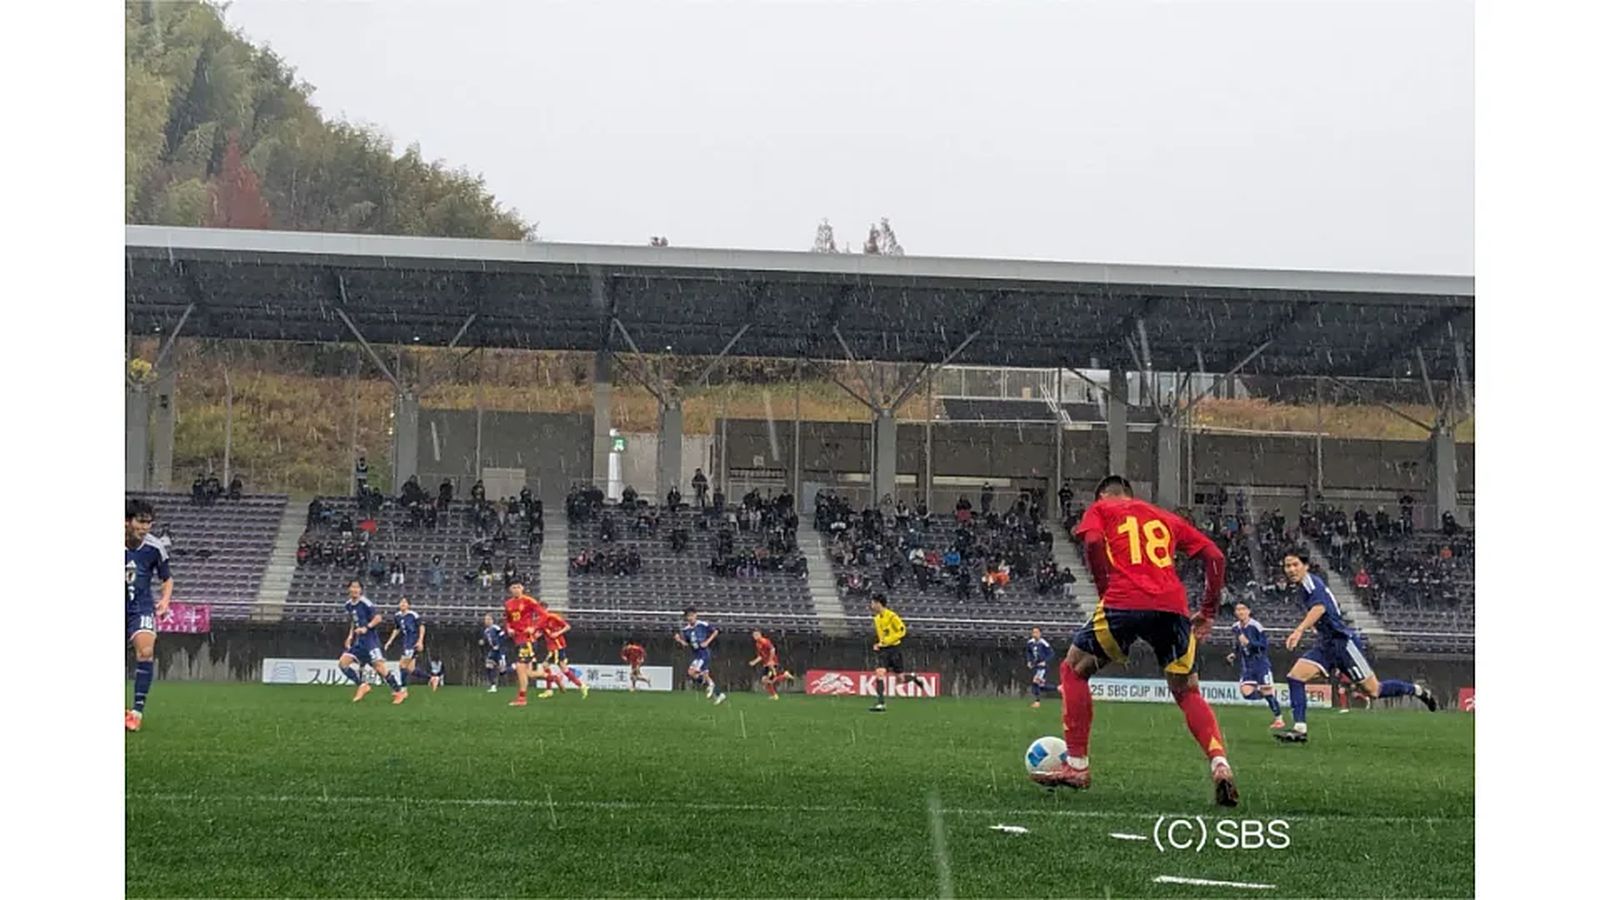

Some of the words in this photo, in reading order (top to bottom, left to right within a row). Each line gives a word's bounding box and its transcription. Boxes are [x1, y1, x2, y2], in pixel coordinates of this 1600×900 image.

[1117, 515, 1172, 569] 18
[587, 667, 628, 682] 第一生
[1107, 684, 1128, 697] SBS
[1130, 685, 1151, 697] CUP
[1154, 685, 1239, 699] INTTIONAL
